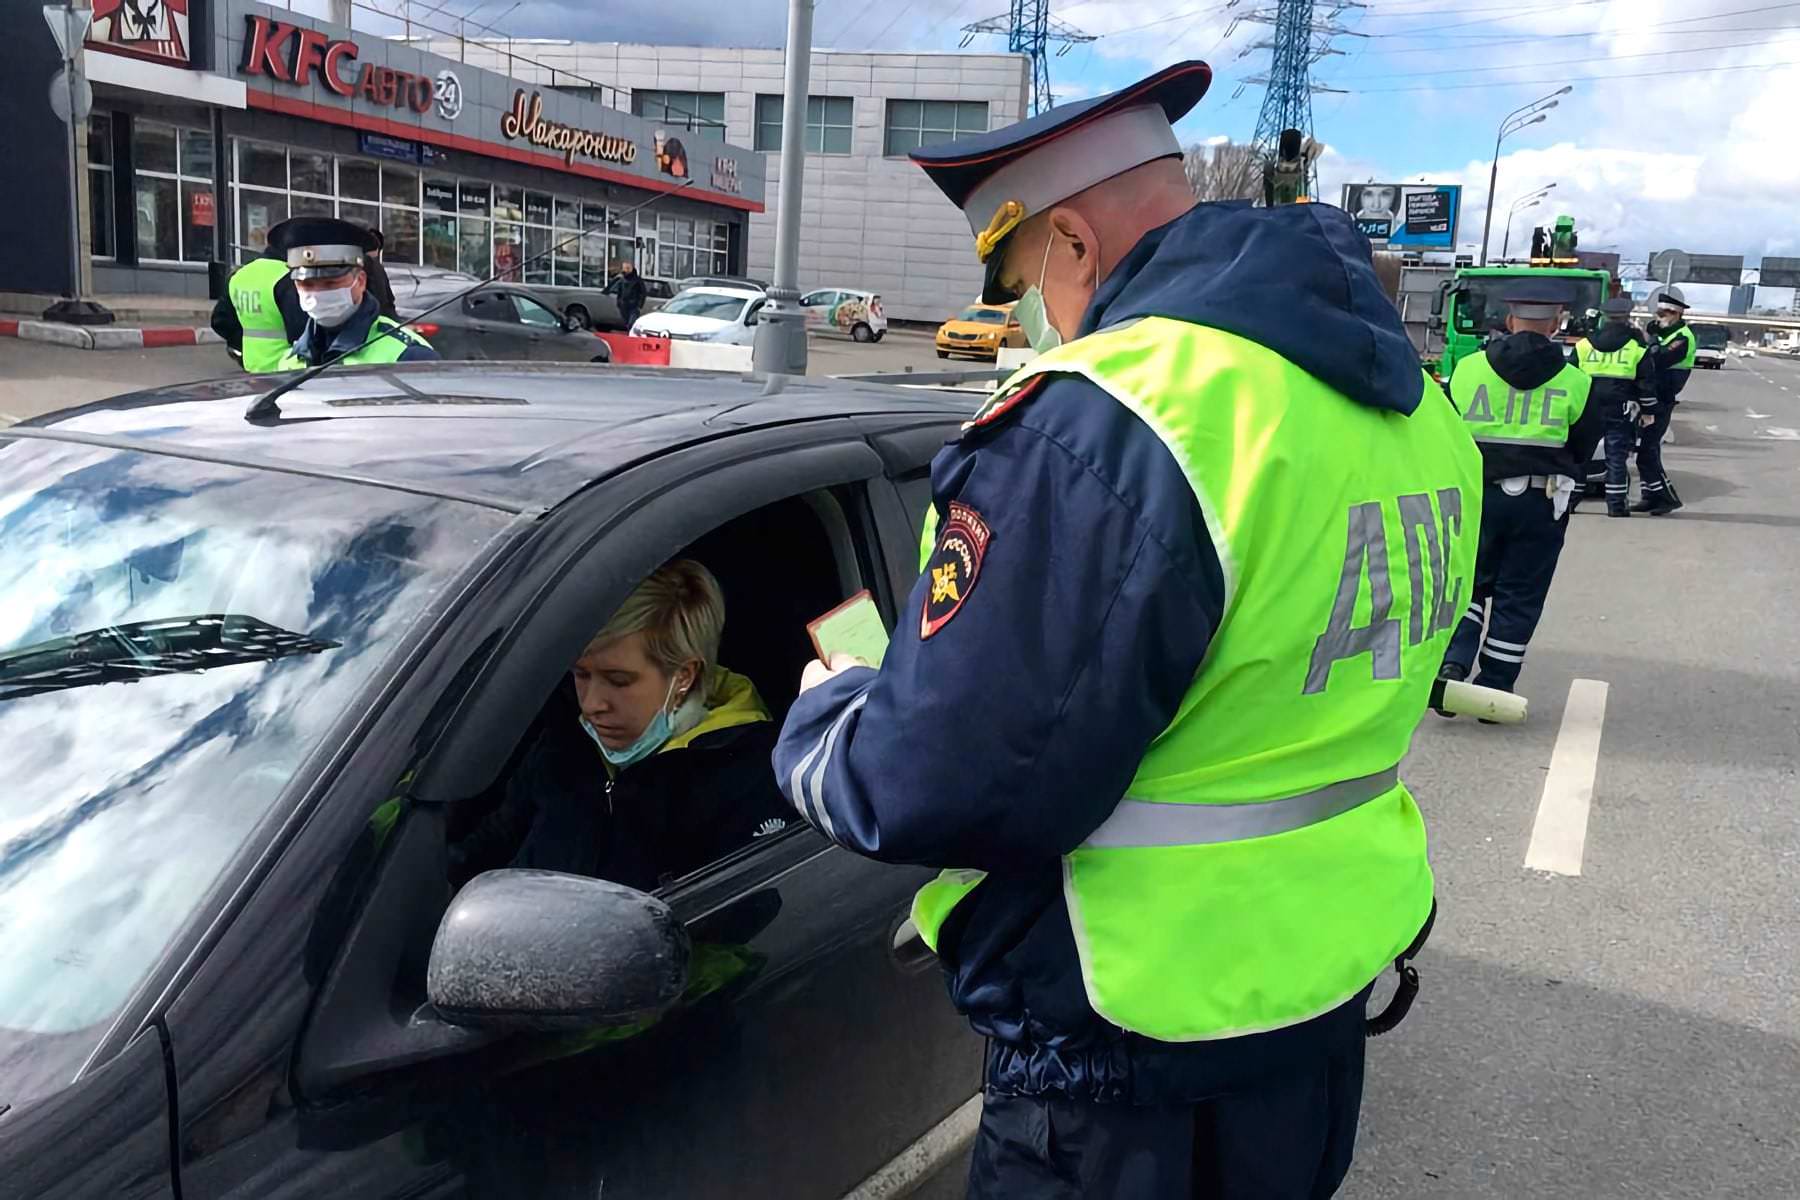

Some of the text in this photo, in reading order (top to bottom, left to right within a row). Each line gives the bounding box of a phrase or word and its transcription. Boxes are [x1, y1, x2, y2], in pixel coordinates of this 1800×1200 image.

[239, 15, 359, 97] KFC
[357, 63, 433, 114] АВТО
[502, 88, 637, 167] Макаронино
[1587, 346, 1630, 364] ДПС
[1463, 383, 1567, 426] ДПС
[942, 537, 973, 578] РОССИЯ
[1302, 487, 1463, 695] ДПС
